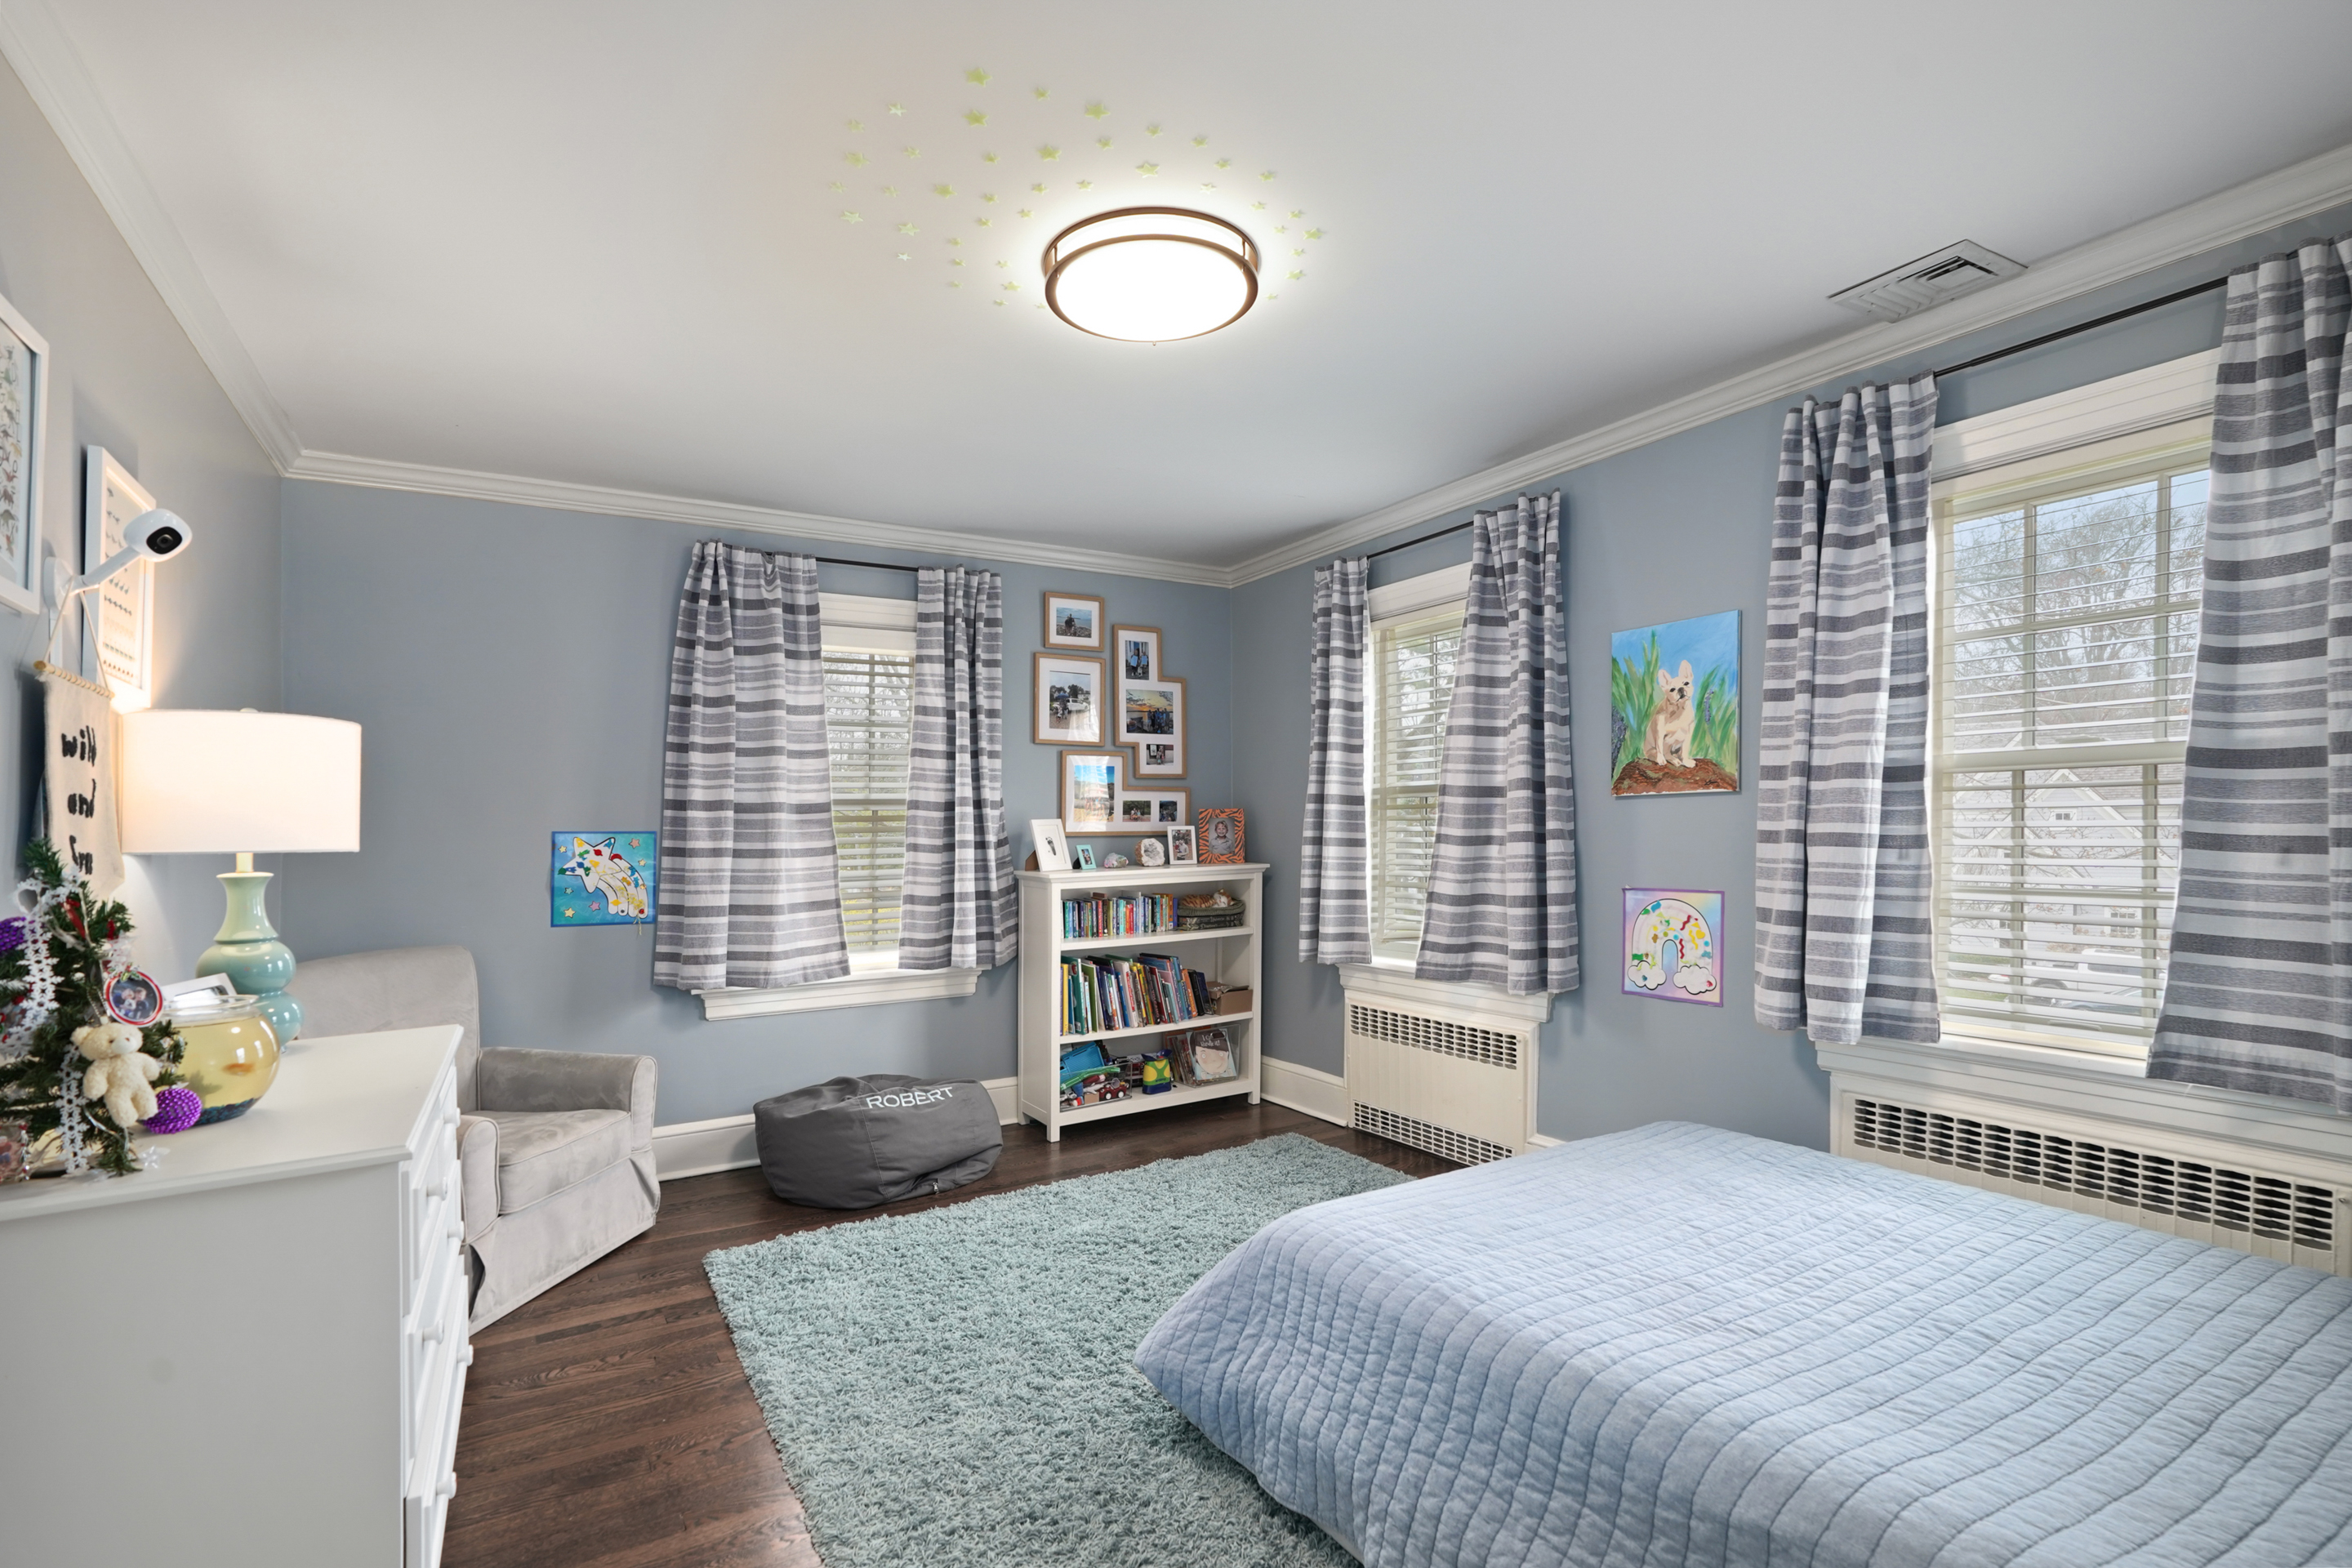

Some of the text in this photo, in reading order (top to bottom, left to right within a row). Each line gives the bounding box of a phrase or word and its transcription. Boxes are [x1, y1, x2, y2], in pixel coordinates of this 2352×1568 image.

[61, 725, 97, 767] wild
[67, 778, 97, 818] and
[866, 1086, 953, 1109] ROBERT
